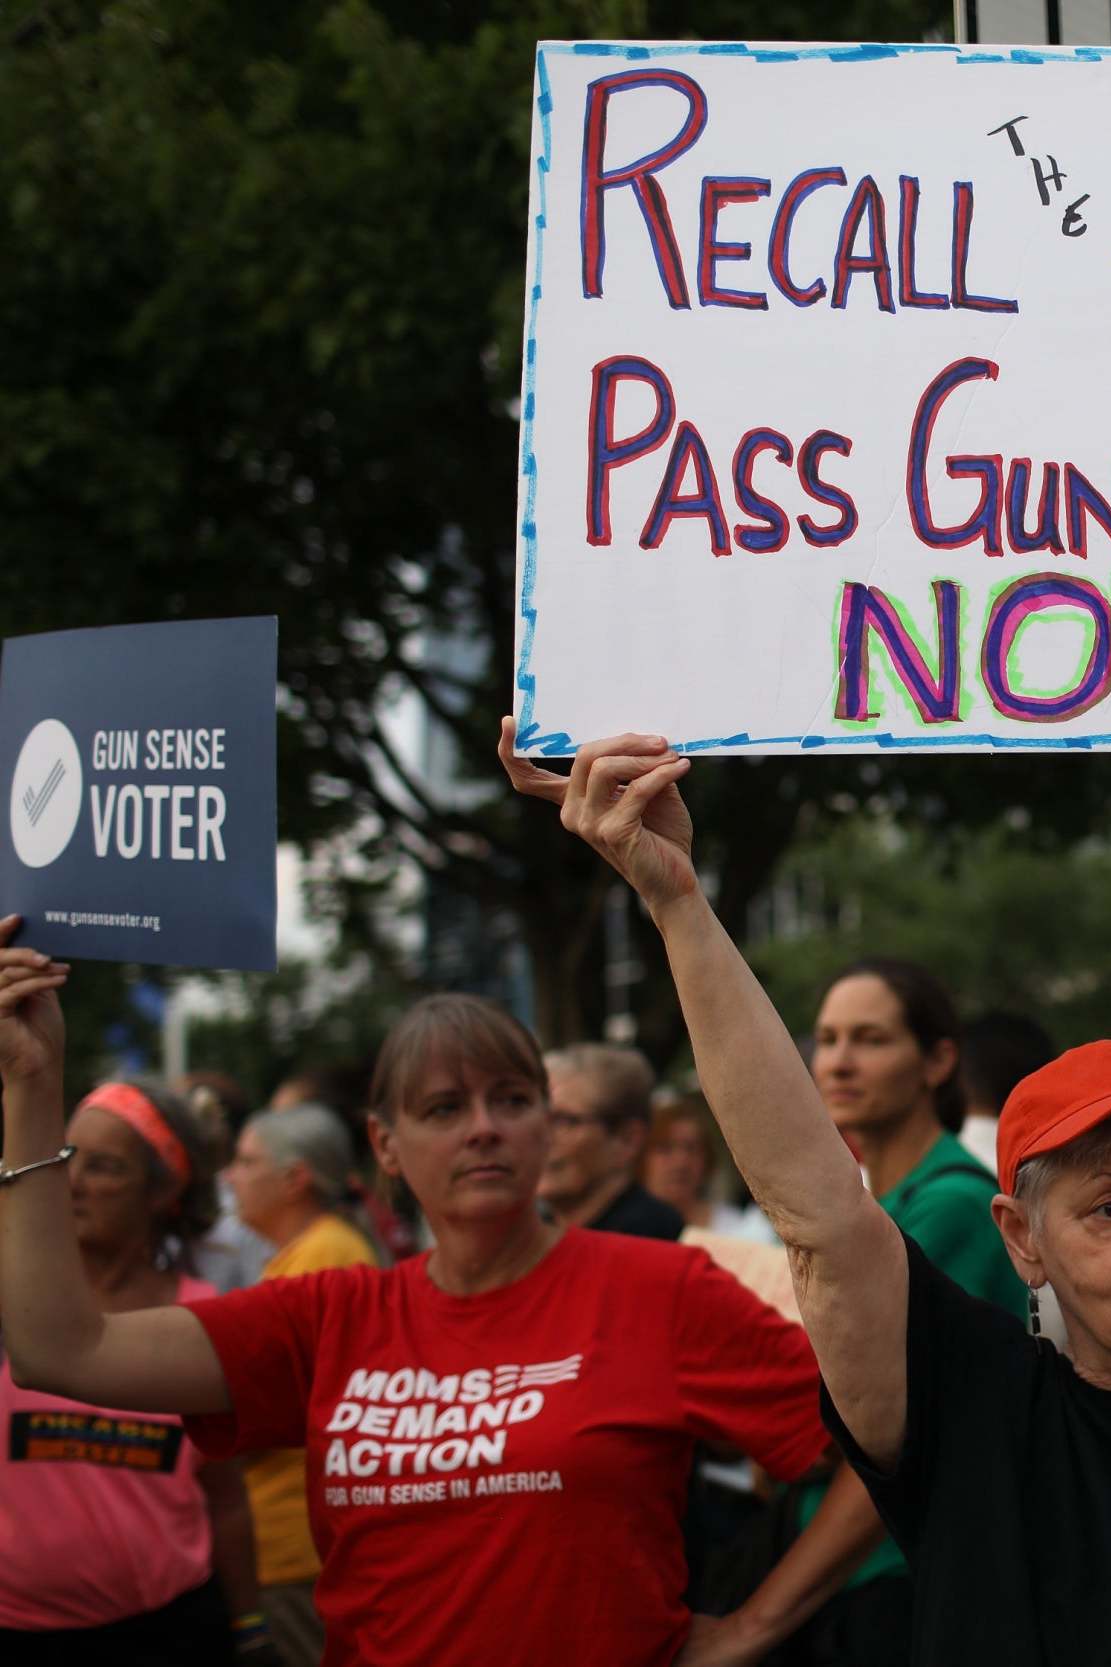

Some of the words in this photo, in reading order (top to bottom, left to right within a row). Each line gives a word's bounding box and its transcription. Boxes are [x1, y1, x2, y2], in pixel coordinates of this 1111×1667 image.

[581, 68, 1019, 314] RECALL
[987, 115, 1090, 237] THE
[586, 355, 859, 557] PASS
[92, 730, 138, 770] GUN
[145, 728, 226, 770] SENSE
[90, 784, 226, 861] VOTER
[45, 910, 160, 931] www.gunsensevoter.org
[343, 1367, 492, 1403] MOMS
[325, 1390, 545, 1439] DEMAND
[325, 1430, 507, 1477] ACTION
[352, 1486, 386, 1505] GUN
[390, 1480, 447, 1504] SENSE
[450, 1478, 469, 1498] IN
[475, 1471, 563, 1496] AMERICA
